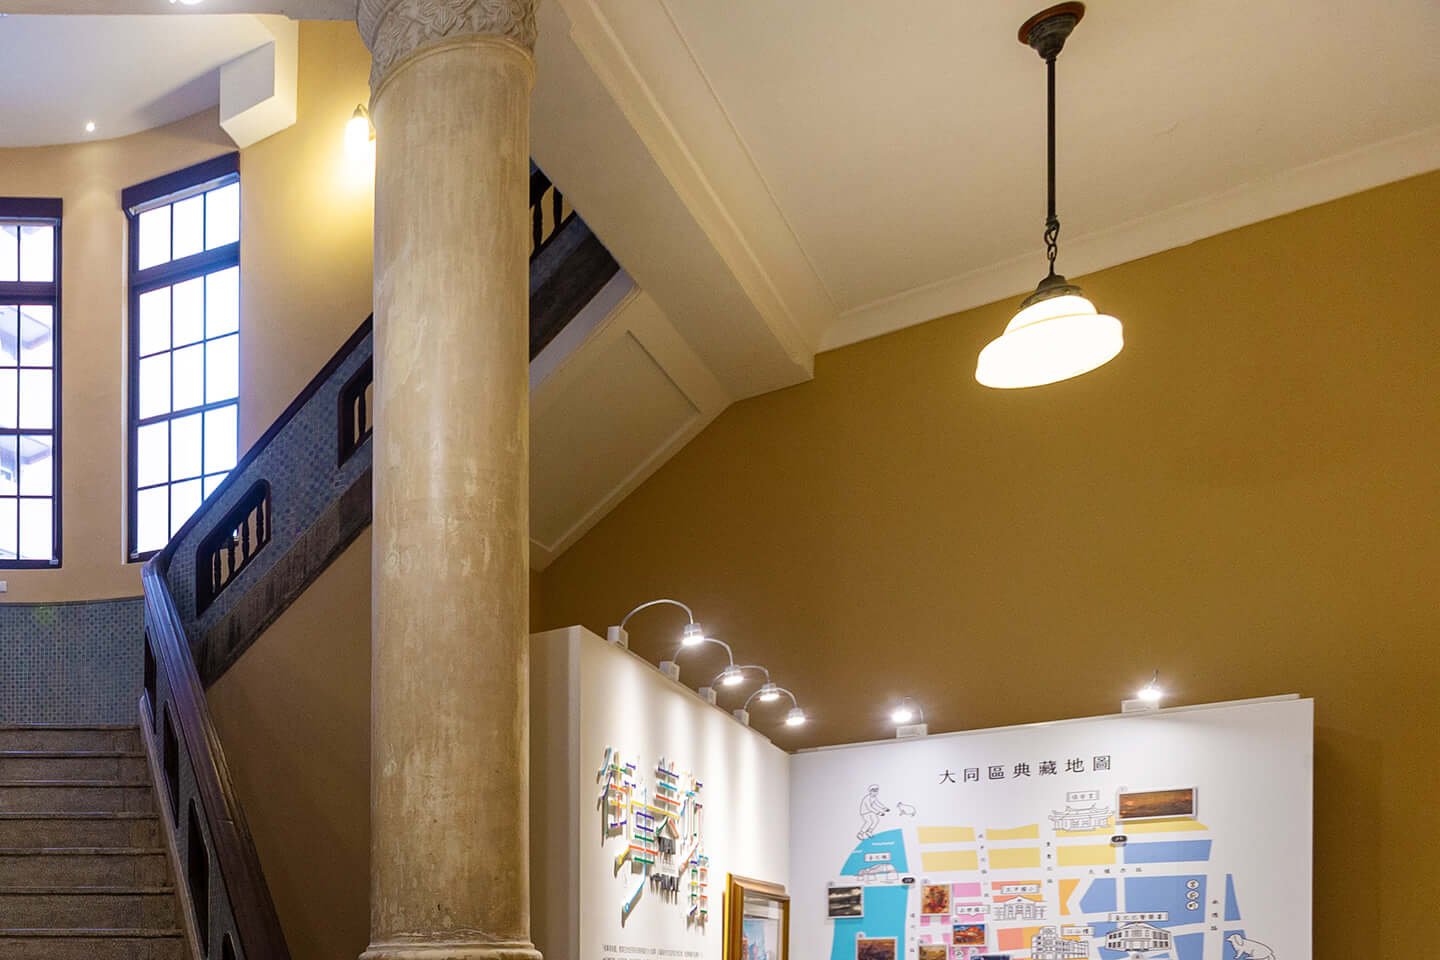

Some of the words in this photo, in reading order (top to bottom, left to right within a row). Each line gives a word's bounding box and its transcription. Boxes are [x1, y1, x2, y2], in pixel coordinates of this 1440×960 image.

[939, 755, 1111, 784] 大同區典藏地圖
